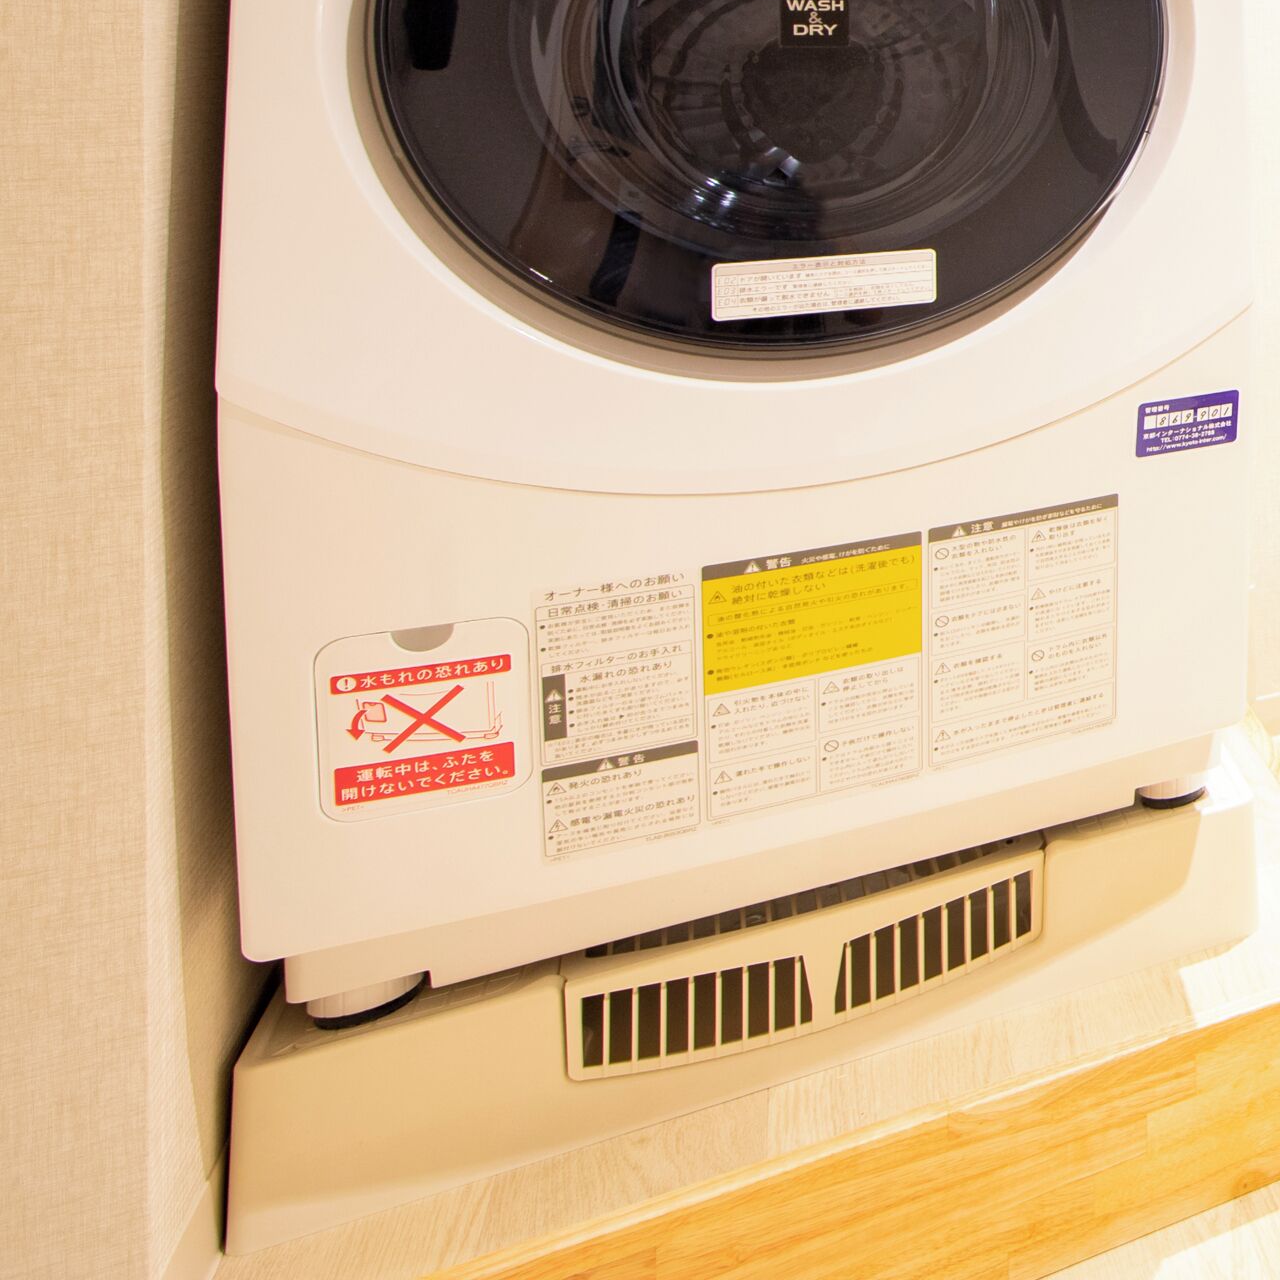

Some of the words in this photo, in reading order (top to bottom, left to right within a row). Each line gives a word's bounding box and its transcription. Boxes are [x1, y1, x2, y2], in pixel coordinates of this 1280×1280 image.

[786, 0, 844, 11] WASH
[808, 11, 823, 24] &
[793, 24, 838, 36] DRY
[970, 521, 994, 533] 注意
[766, 556, 792, 569] 警告
[544, 572, 685, 601] オーナー様へのお願い
[731, 581, 827, 605] 絶対に乾燥しない
[550, 644, 684, 674] 排水フィルターのお手入れ
[360, 658, 505, 689] 水もれの恐れあり
[579, 659, 673, 684] 水漏れの恐れあり
[356, 750, 495, 784] 運転中は、ふたを
[341, 766, 511, 802] 開けないでください。
